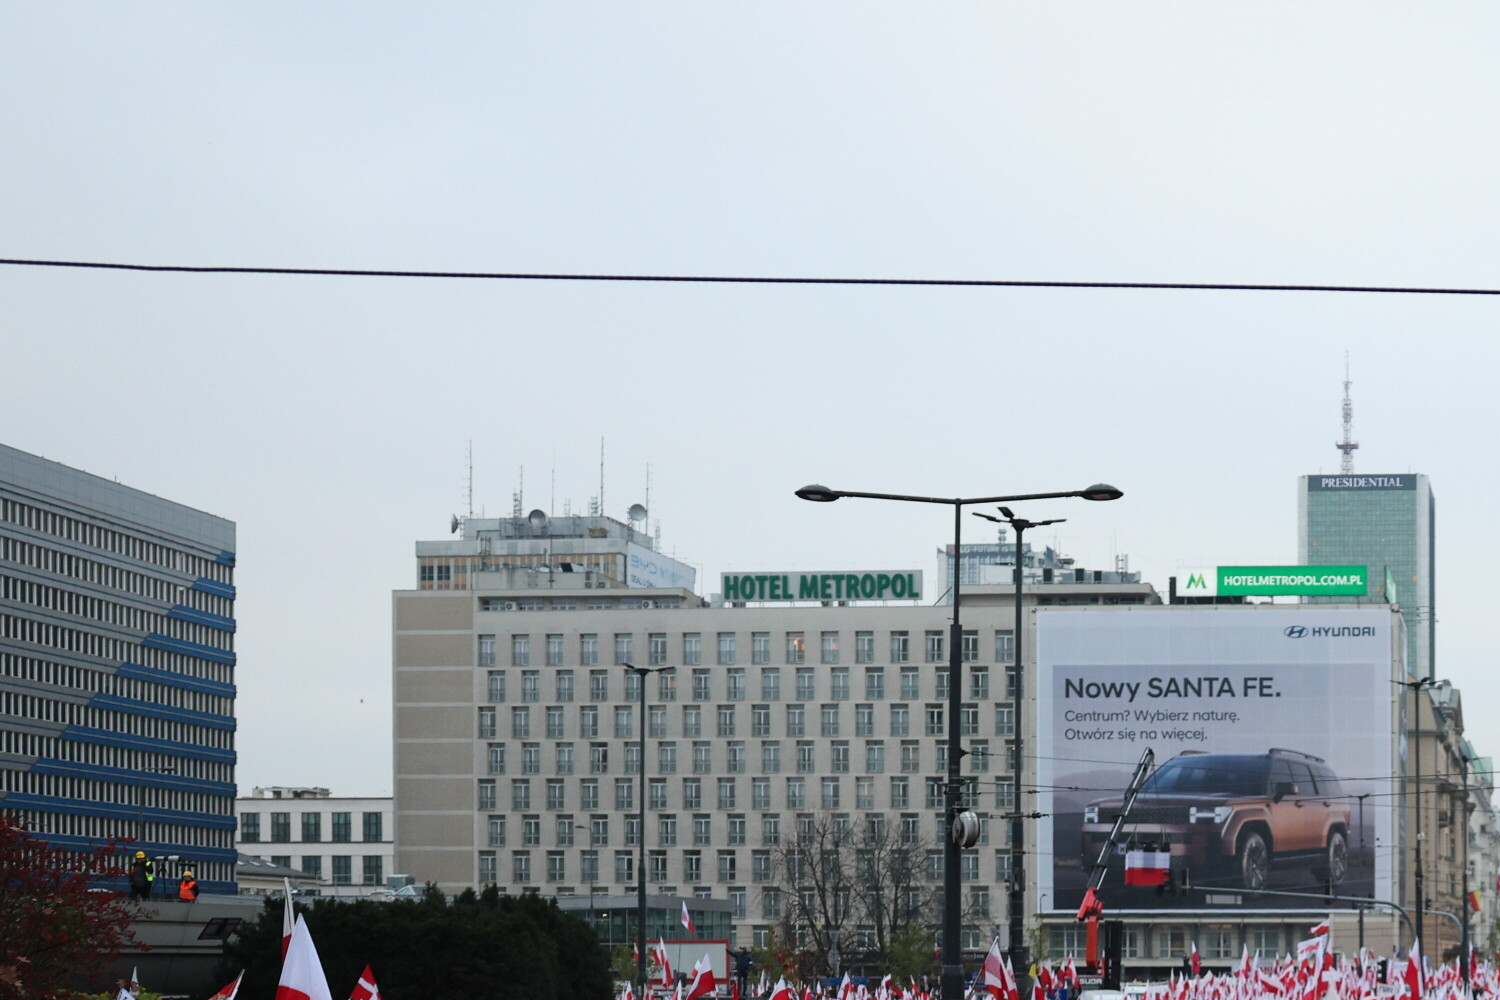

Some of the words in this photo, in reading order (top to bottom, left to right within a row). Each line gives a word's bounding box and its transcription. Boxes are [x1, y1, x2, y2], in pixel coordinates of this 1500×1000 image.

[1321, 477, 1403, 488] PRESIDENTIAL
[631, 554, 657, 575] BYD
[724, 575, 793, 600] HOTEL
[799, 573, 919, 599] METROPOL
[1223, 574, 1363, 587] HOTELMETROPOL.COM.PL
[1312, 626, 1376, 638] HYUNDAI
[1064, 677, 1140, 702] Nowy
[1147, 676, 1236, 698] SANTA
[1242, 676, 1281, 698] FE.
[1064, 709, 1131, 722] Centrum?
[1134, 709, 1189, 725] Wybierz
[1192, 710, 1240, 724] naturę.
[1064, 727, 1115, 741] Otwórz
[1117, 727, 1137, 743] się
[1139, 731, 1158, 741] na
[1160, 727, 1208, 743] więcej.
